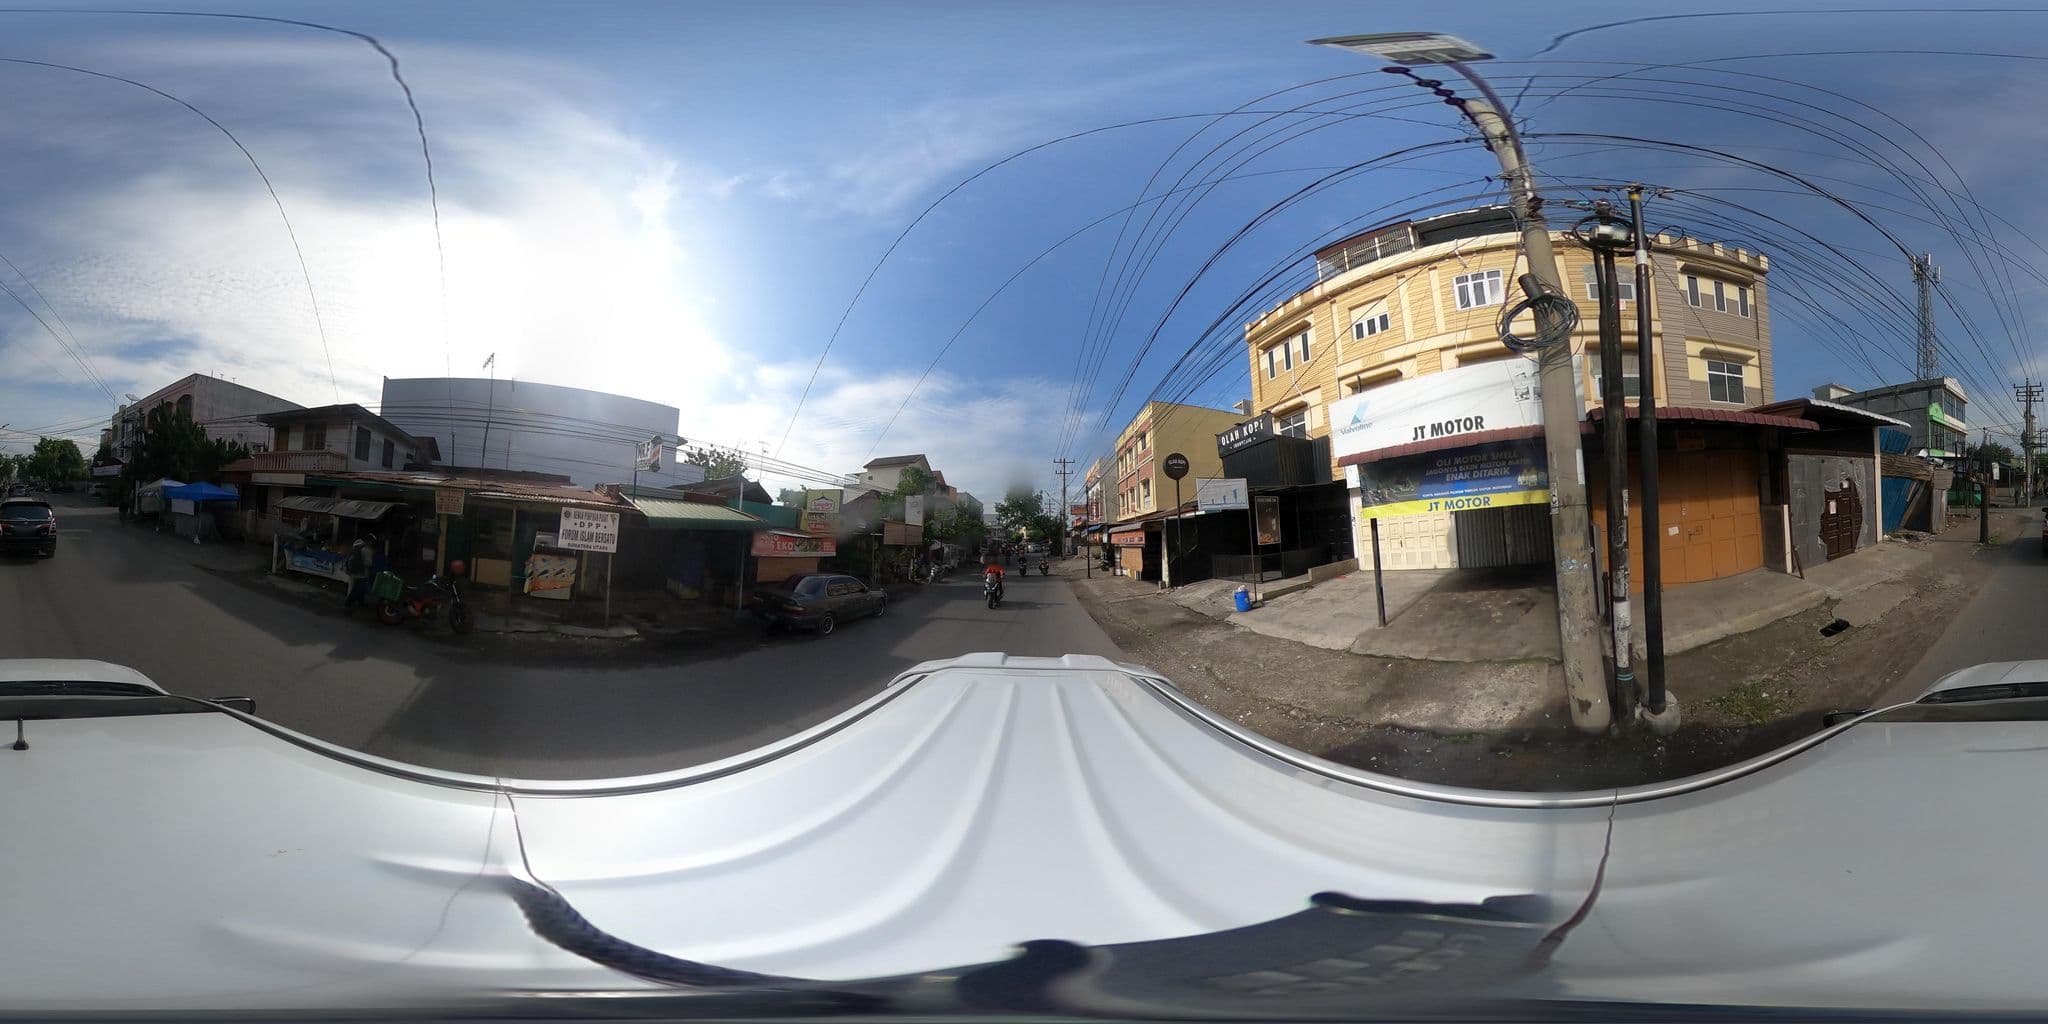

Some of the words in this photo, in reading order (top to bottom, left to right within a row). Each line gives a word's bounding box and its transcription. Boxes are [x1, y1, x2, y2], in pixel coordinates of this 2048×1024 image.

[1412, 425, 1426, 441] JT
[1430, 415, 1485, 438] MOTOR
[1221, 429, 1240, 446] OLAH
[1436, 459, 1451, 467] OLI
[1454, 454, 1488, 465] MOTOR
[1480, 460, 1506, 469] MOTOR
[1446, 471, 1471, 482] ENAK
[1472, 467, 1511, 480] DITARIK
[1428, 501, 1440, 512] JT
[1444, 496, 1491, 510] MOTOR
[561, 528, 579, 541] FORUM
[579, 530, 595, 542] ISLAM
[594, 531, 616, 545] BERSATU
